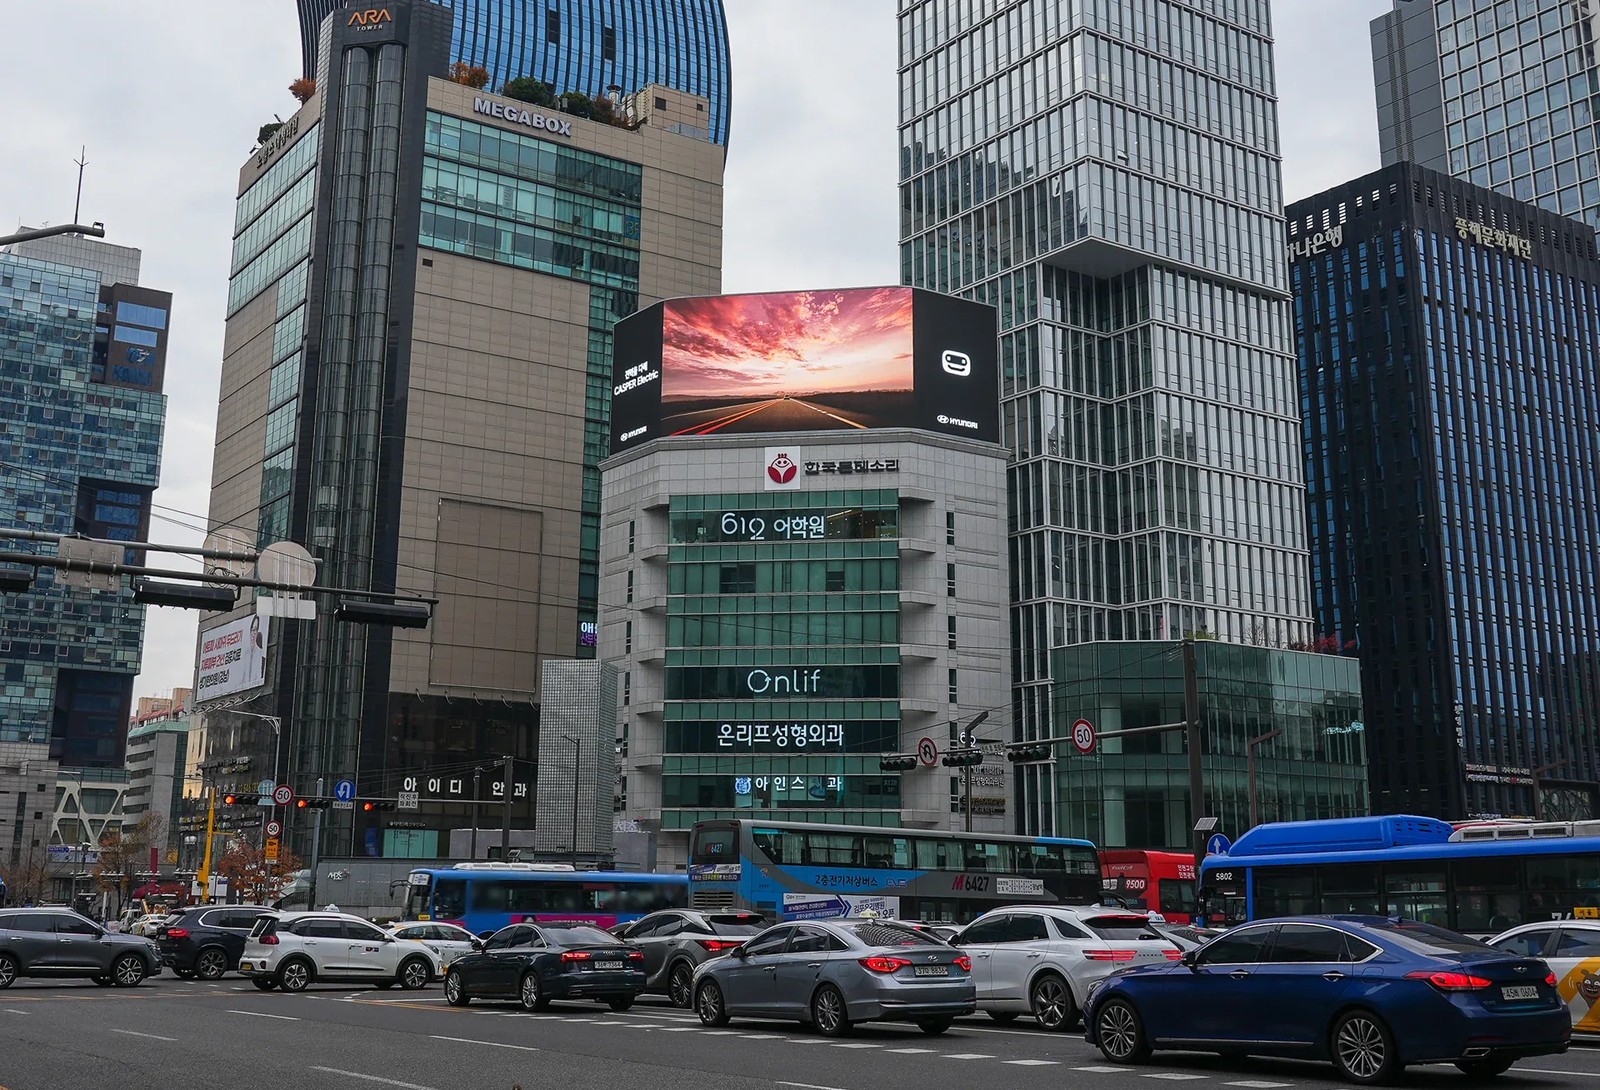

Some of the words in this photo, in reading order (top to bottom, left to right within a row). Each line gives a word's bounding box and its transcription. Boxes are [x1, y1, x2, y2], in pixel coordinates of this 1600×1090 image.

[348, 8, 392, 26] ARA
[356, 24, 384, 32] TOWER
[473, 97, 572, 137] MEGABOX
[614, 378, 637, 396] CASPER
[637, 369, 659, 387] Electric
[950, 418, 978, 430] HYUNDAI
[721, 512, 765, 540] 612
[774, 515, 825, 540] 어학원
[747, 669, 821, 693] Onlif
[717, 724, 845, 747] 온리프성형외과
[1077, 729, 1091, 743] 50
[403, 777, 462, 794] 아이디
[492, 781, 527, 797] 안과
[277, 791, 290, 799] 50
[269, 824, 278, 832] 50
[1215, 872, 1233, 881] 5802
[1126, 880, 1145, 889] 9500
[883, 908, 895, 919] 오픈
